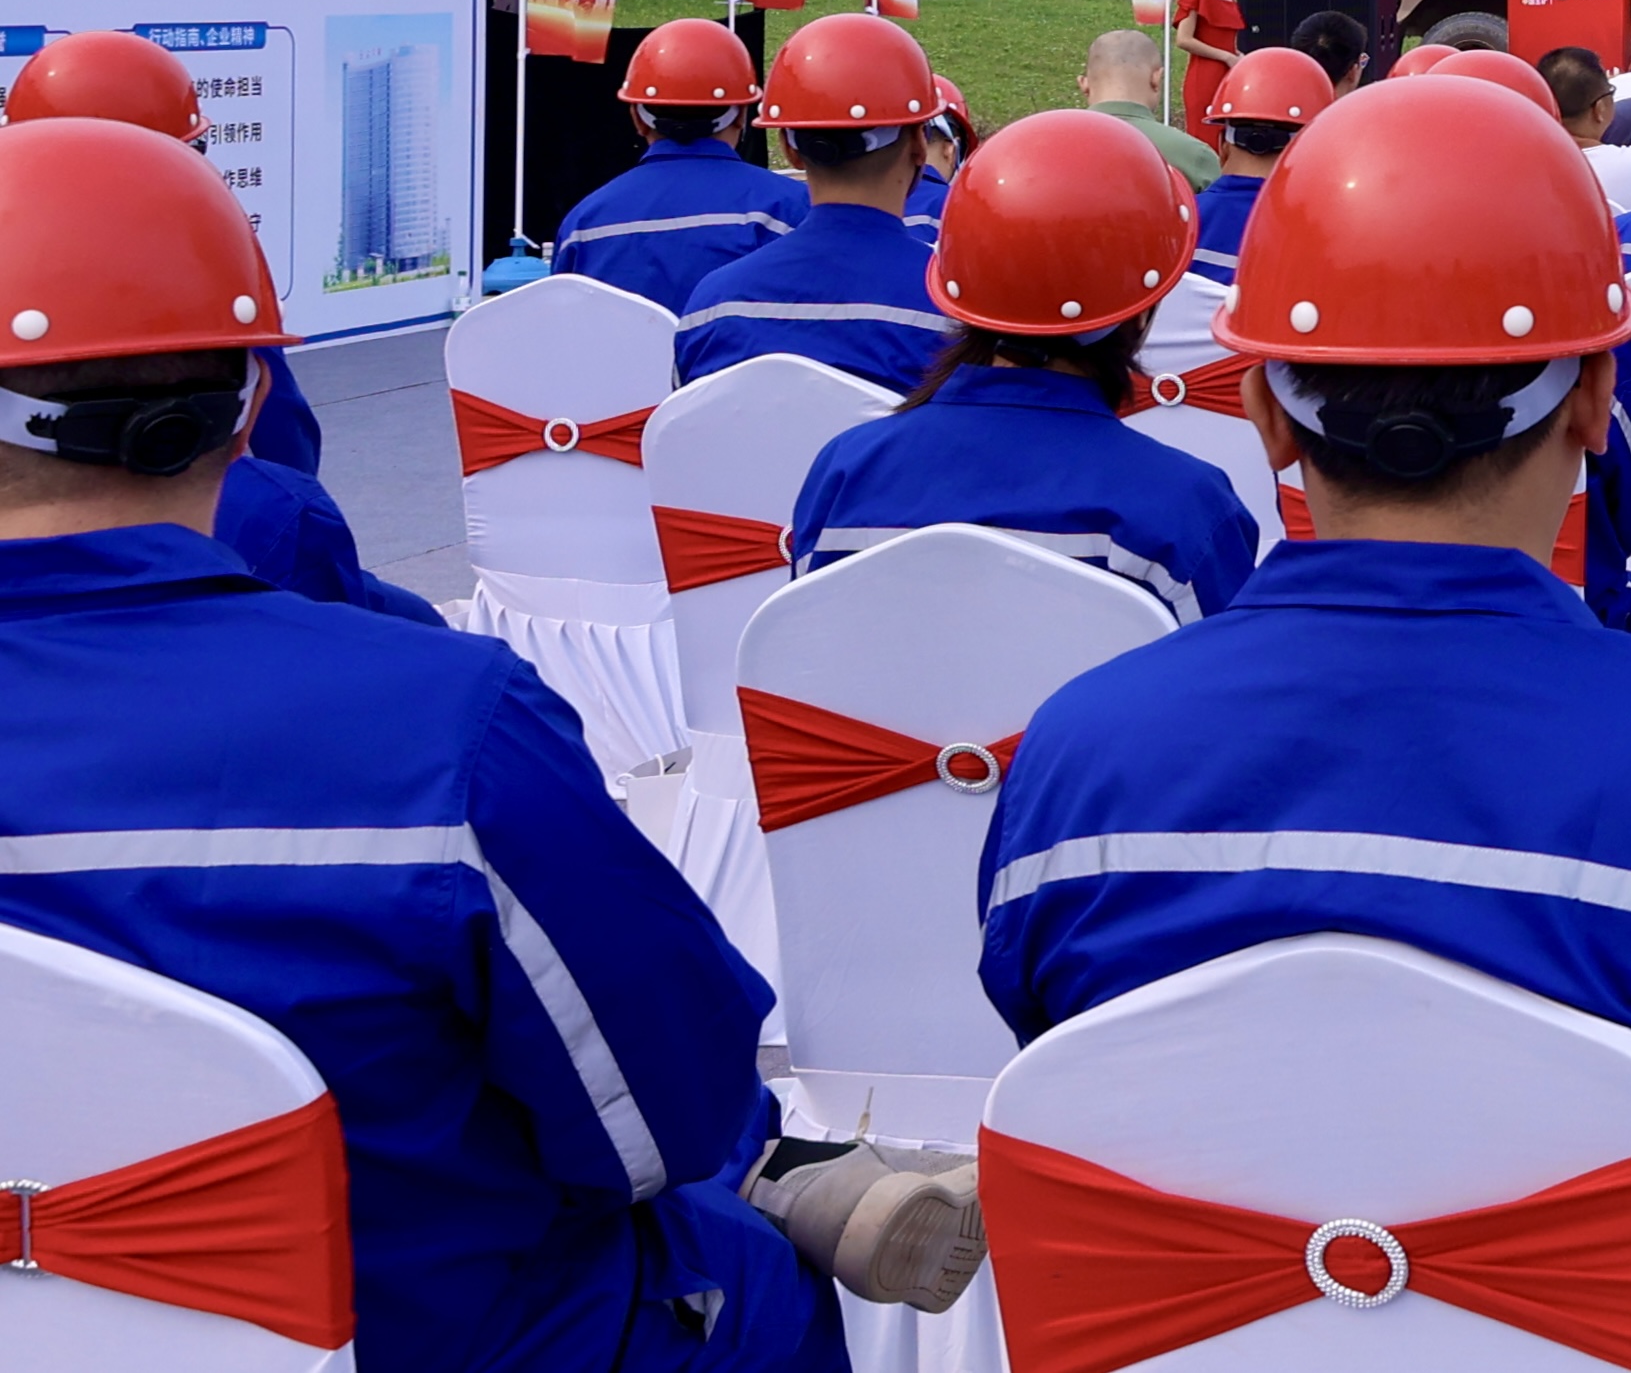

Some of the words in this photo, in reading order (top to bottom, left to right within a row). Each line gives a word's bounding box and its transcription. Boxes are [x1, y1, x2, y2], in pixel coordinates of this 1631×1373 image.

[192, 76, 262, 99] 的使命担当
